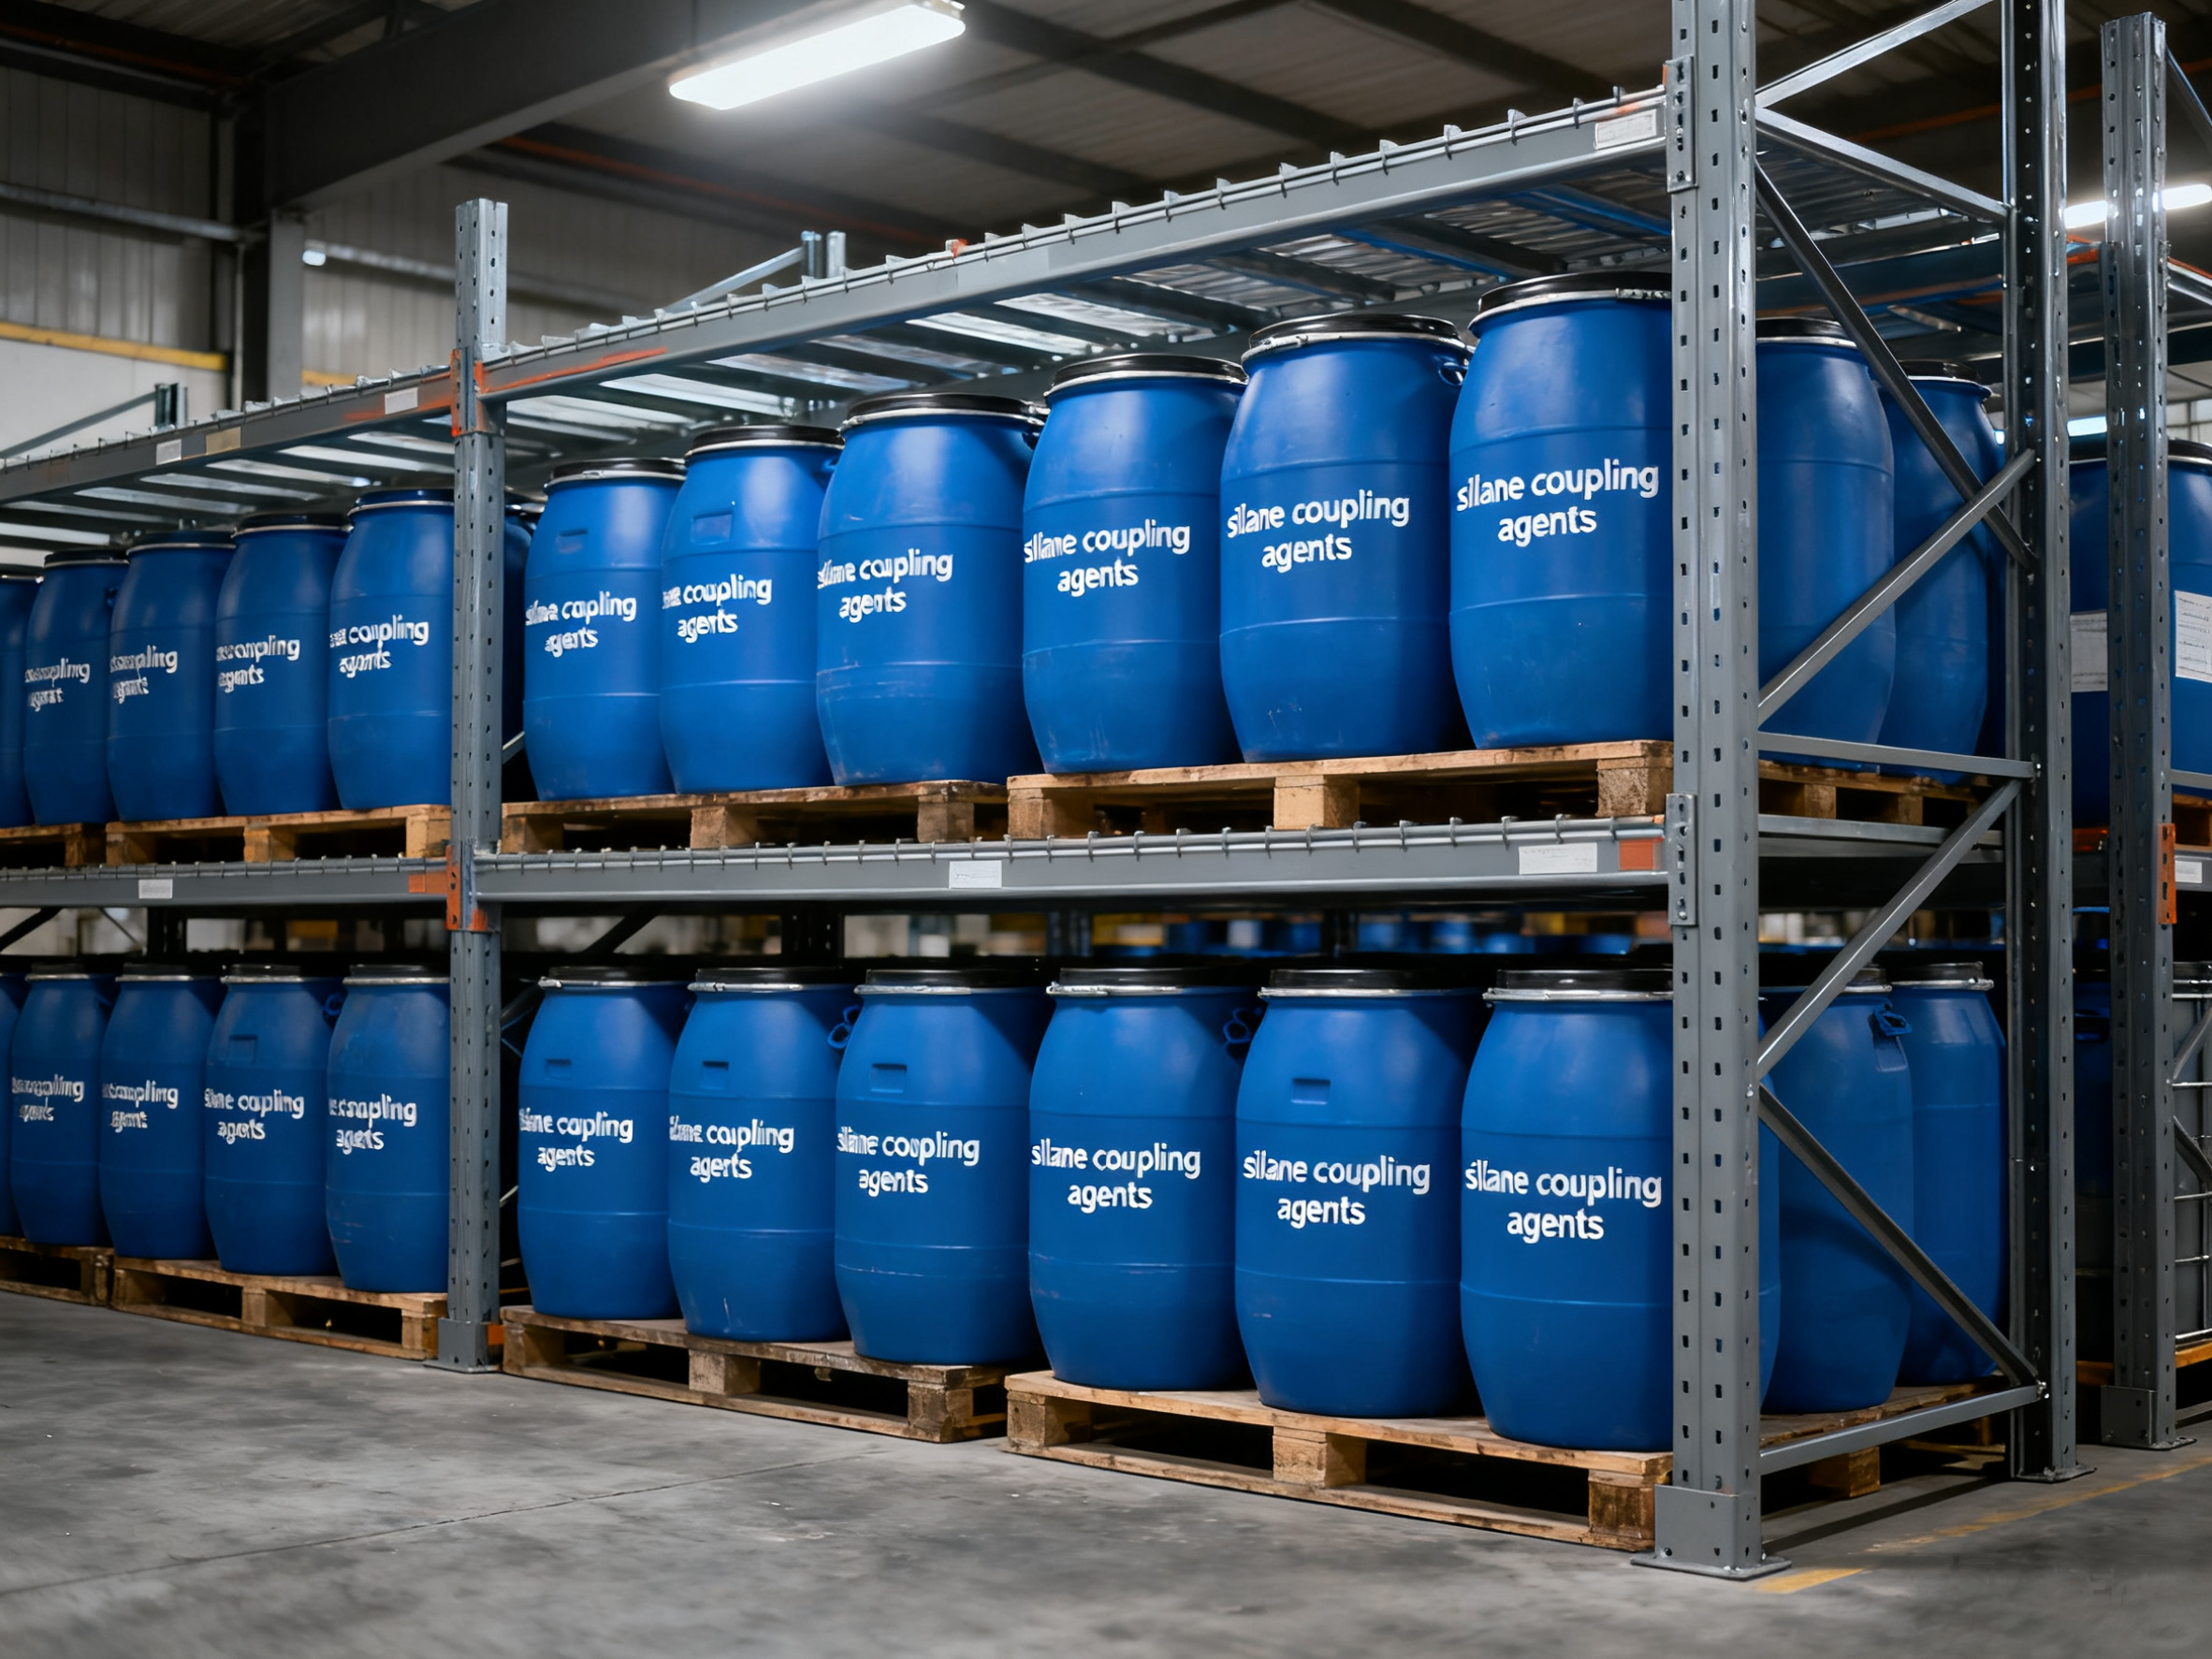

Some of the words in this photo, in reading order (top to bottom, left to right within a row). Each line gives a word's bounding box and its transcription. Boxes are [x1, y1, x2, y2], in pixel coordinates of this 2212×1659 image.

[1530, 458, 1659, 499] coupling
[1291, 488, 1410, 529] coupling
[1497, 505, 1597, 547] agents
[1082, 518, 1190, 557] coupling
[1261, 532, 1353, 574] agents
[1056, 554, 1139, 598] agents
[1091, 1142, 1201, 1180] coupling
[1313, 1155, 1431, 1195] coupling
[1067, 1181, 1154, 1215] agents
[1535, 1166, 1662, 1208] coupling
[1276, 1196, 1366, 1230] agents
[1506, 1208, 1605, 1244] agents
